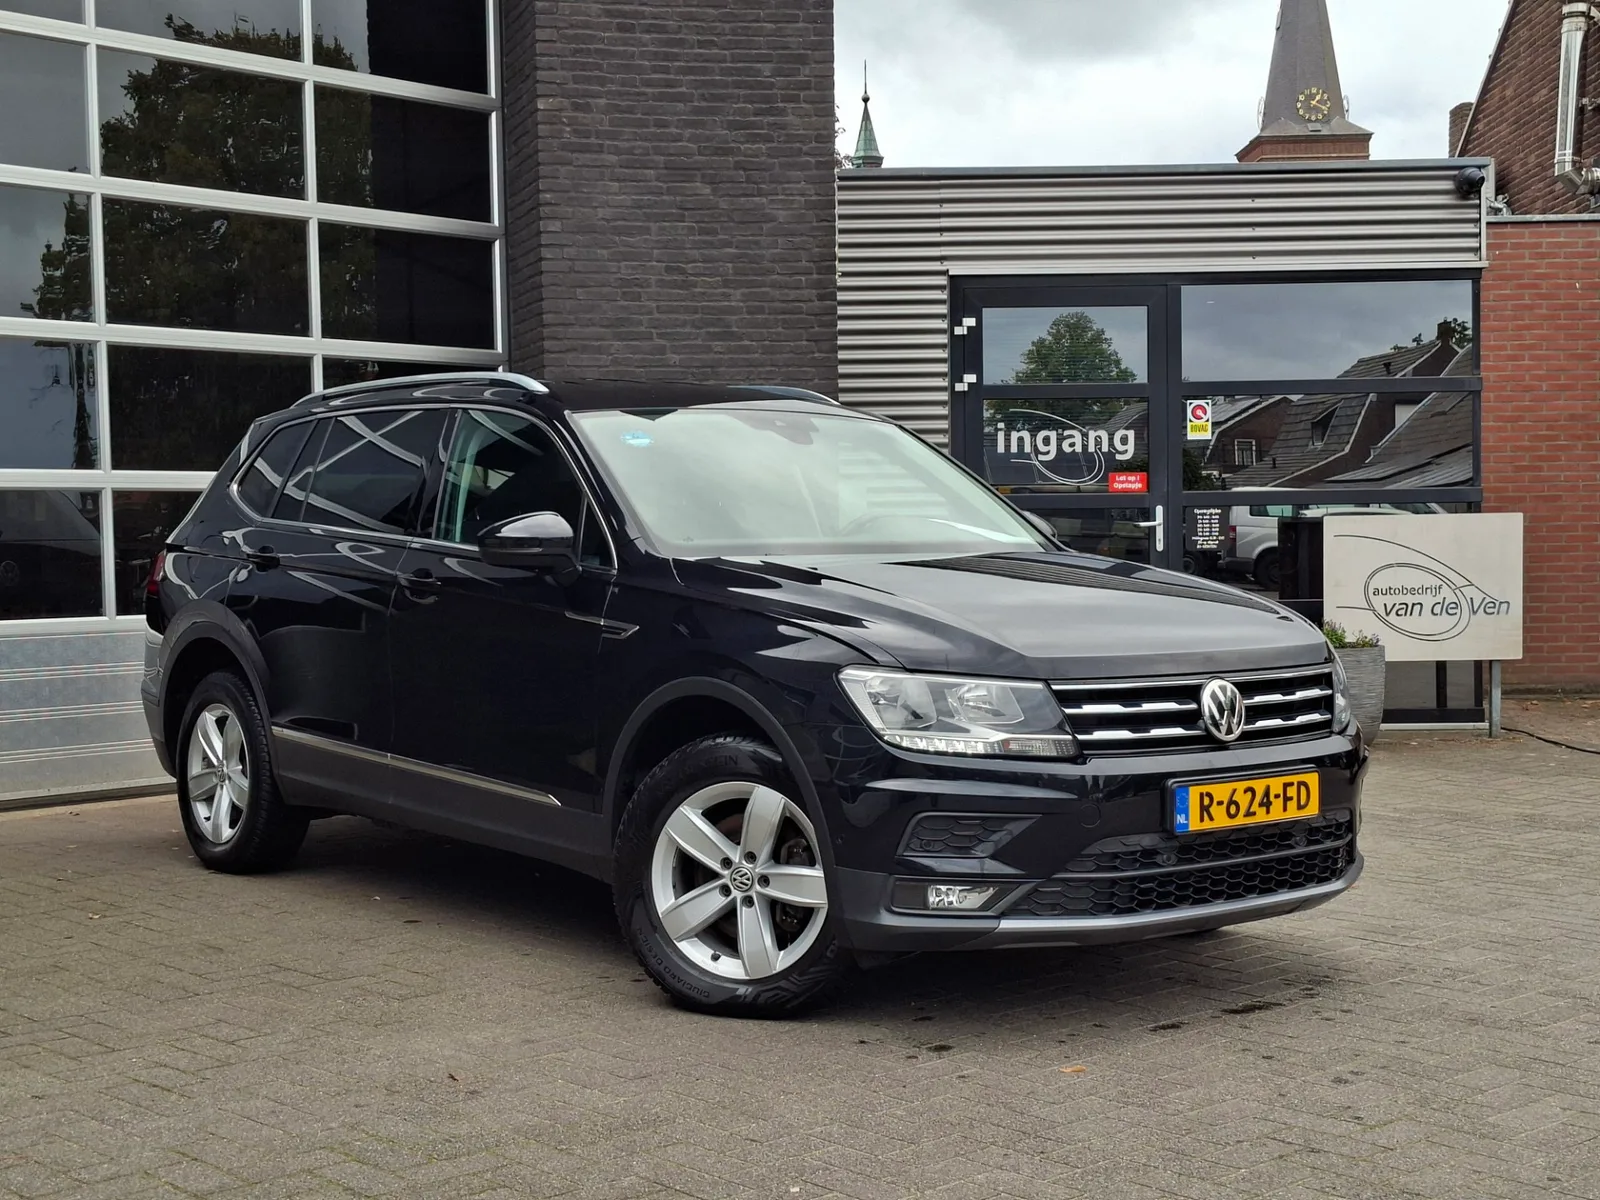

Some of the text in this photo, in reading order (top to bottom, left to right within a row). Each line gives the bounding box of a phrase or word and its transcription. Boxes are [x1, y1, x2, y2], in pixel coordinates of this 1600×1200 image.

[997, 422, 1135, 461] ingang
[1372, 584, 1444, 598] autobedrijf
[1383, 597, 1511, 617] van de Ven
[1199, 780, 1312, 823] R-624-FD
[1176, 813, 1189, 824] NL
